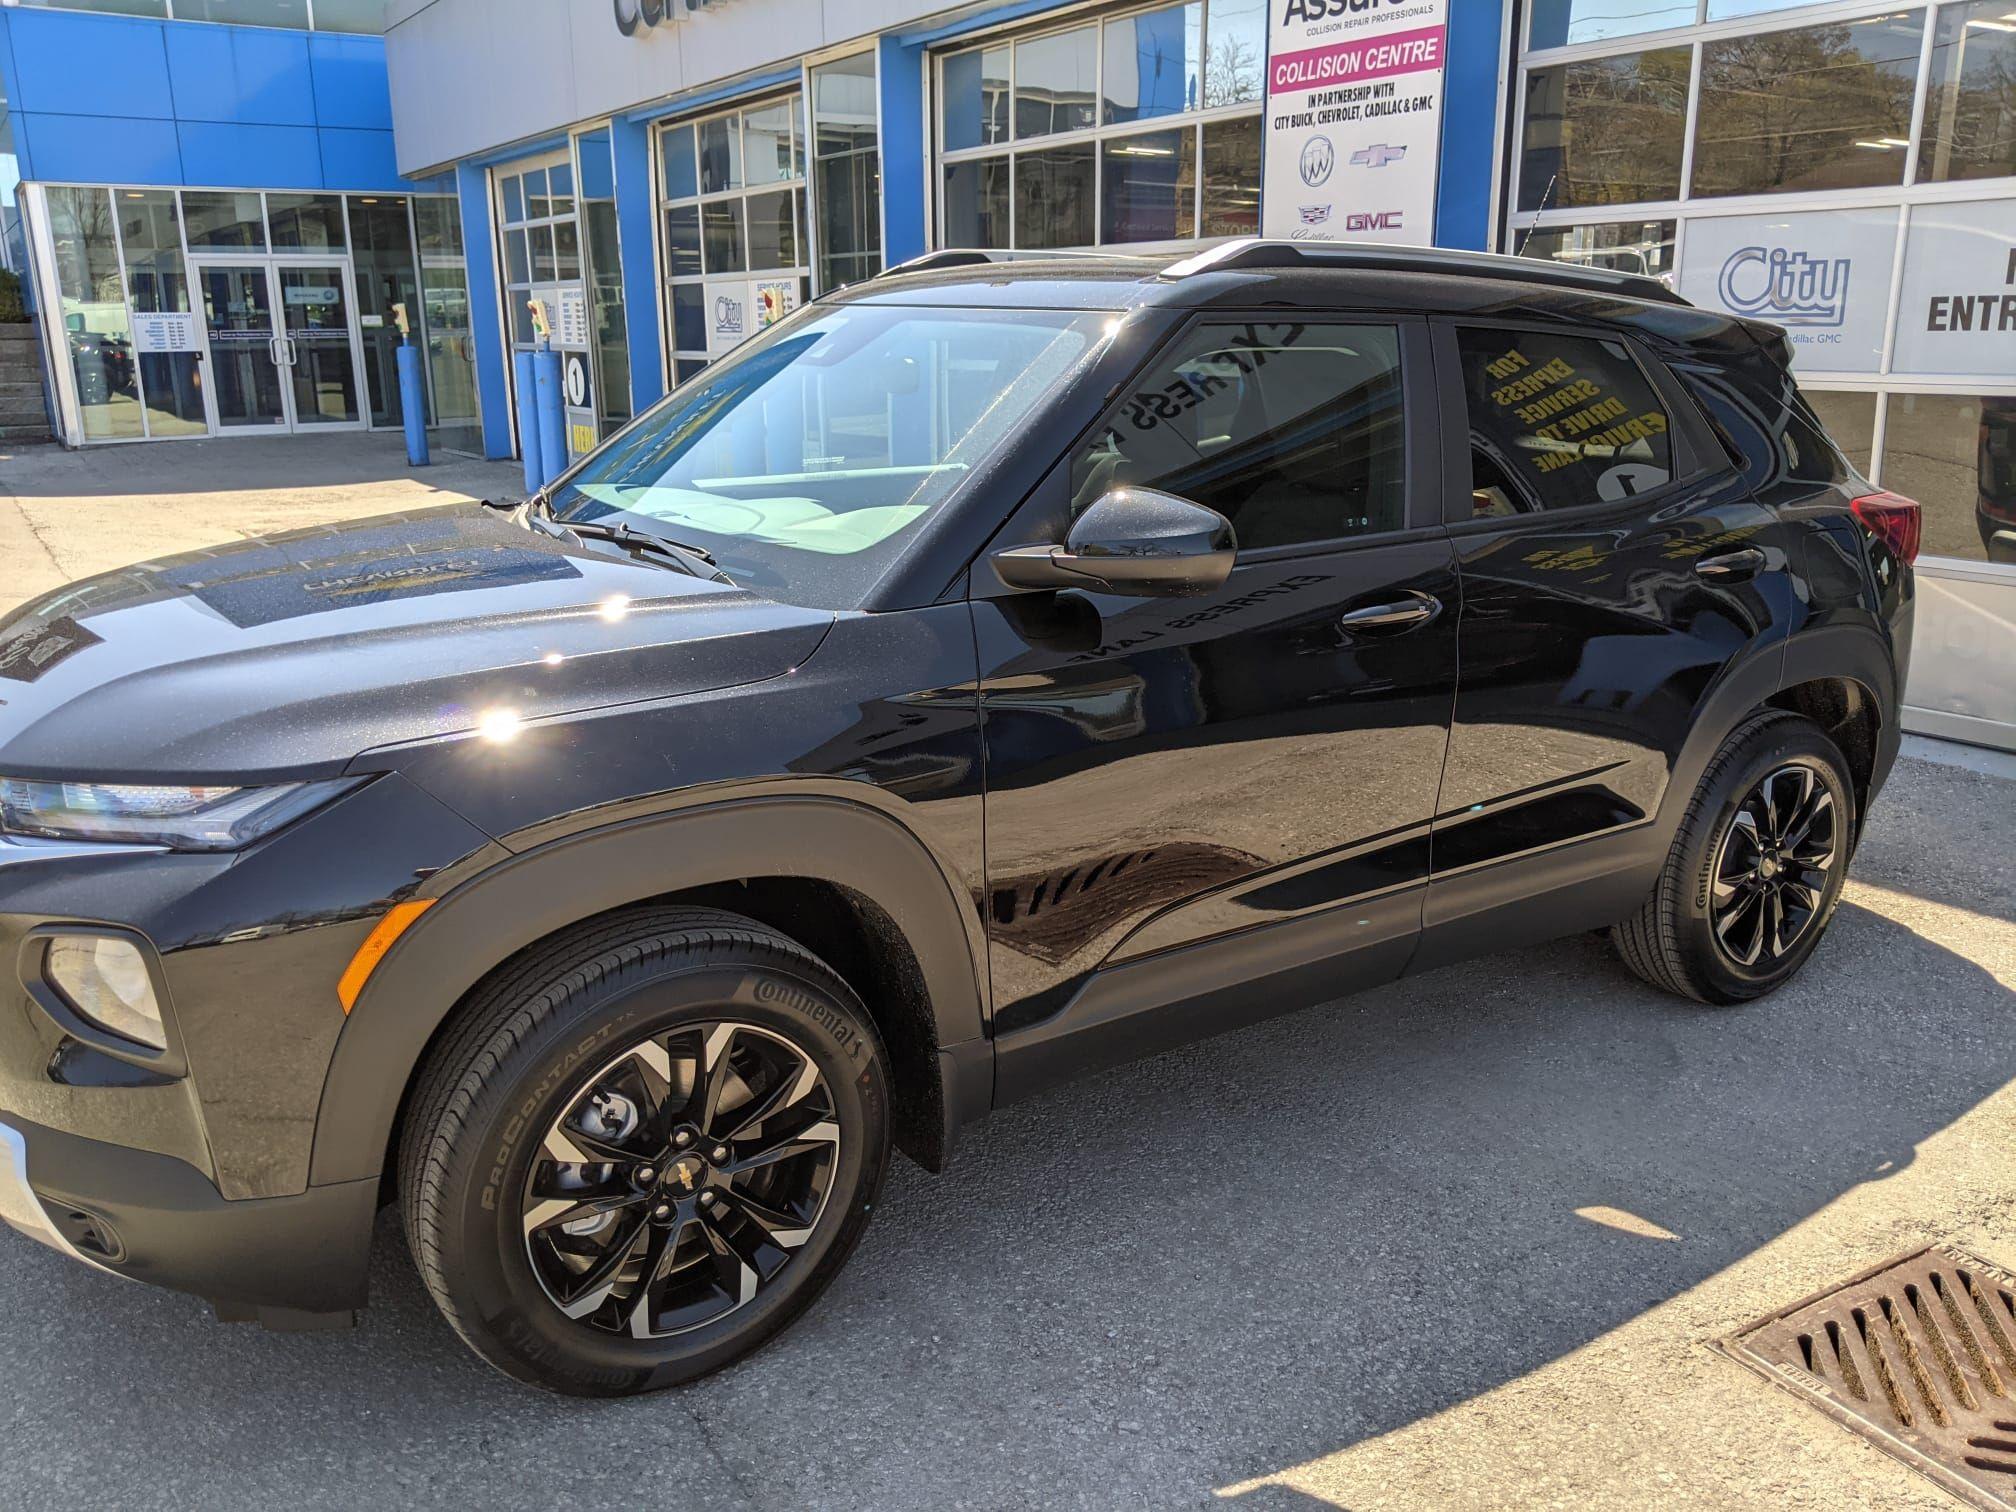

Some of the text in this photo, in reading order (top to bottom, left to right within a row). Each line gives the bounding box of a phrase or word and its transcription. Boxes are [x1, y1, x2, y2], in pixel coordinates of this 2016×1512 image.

[1307, 5, 1434, 36] COLLISION REPAIR PROFESSIONALS
[1276, 38, 1438, 86] COLLISION CENTRE
[1308, 82, 1395, 108] IN PARTNERSHIP WITH
[1274, 95, 1433, 130] CITY BUICK, CHEVROLET, CADILLAC & GMC
[1346, 210, 1403, 231] GMC
[1718, 246, 1851, 327] City
[1789, 333, 1842, 344] dillac GMC
[753, 979, 856, 1047] Continental
